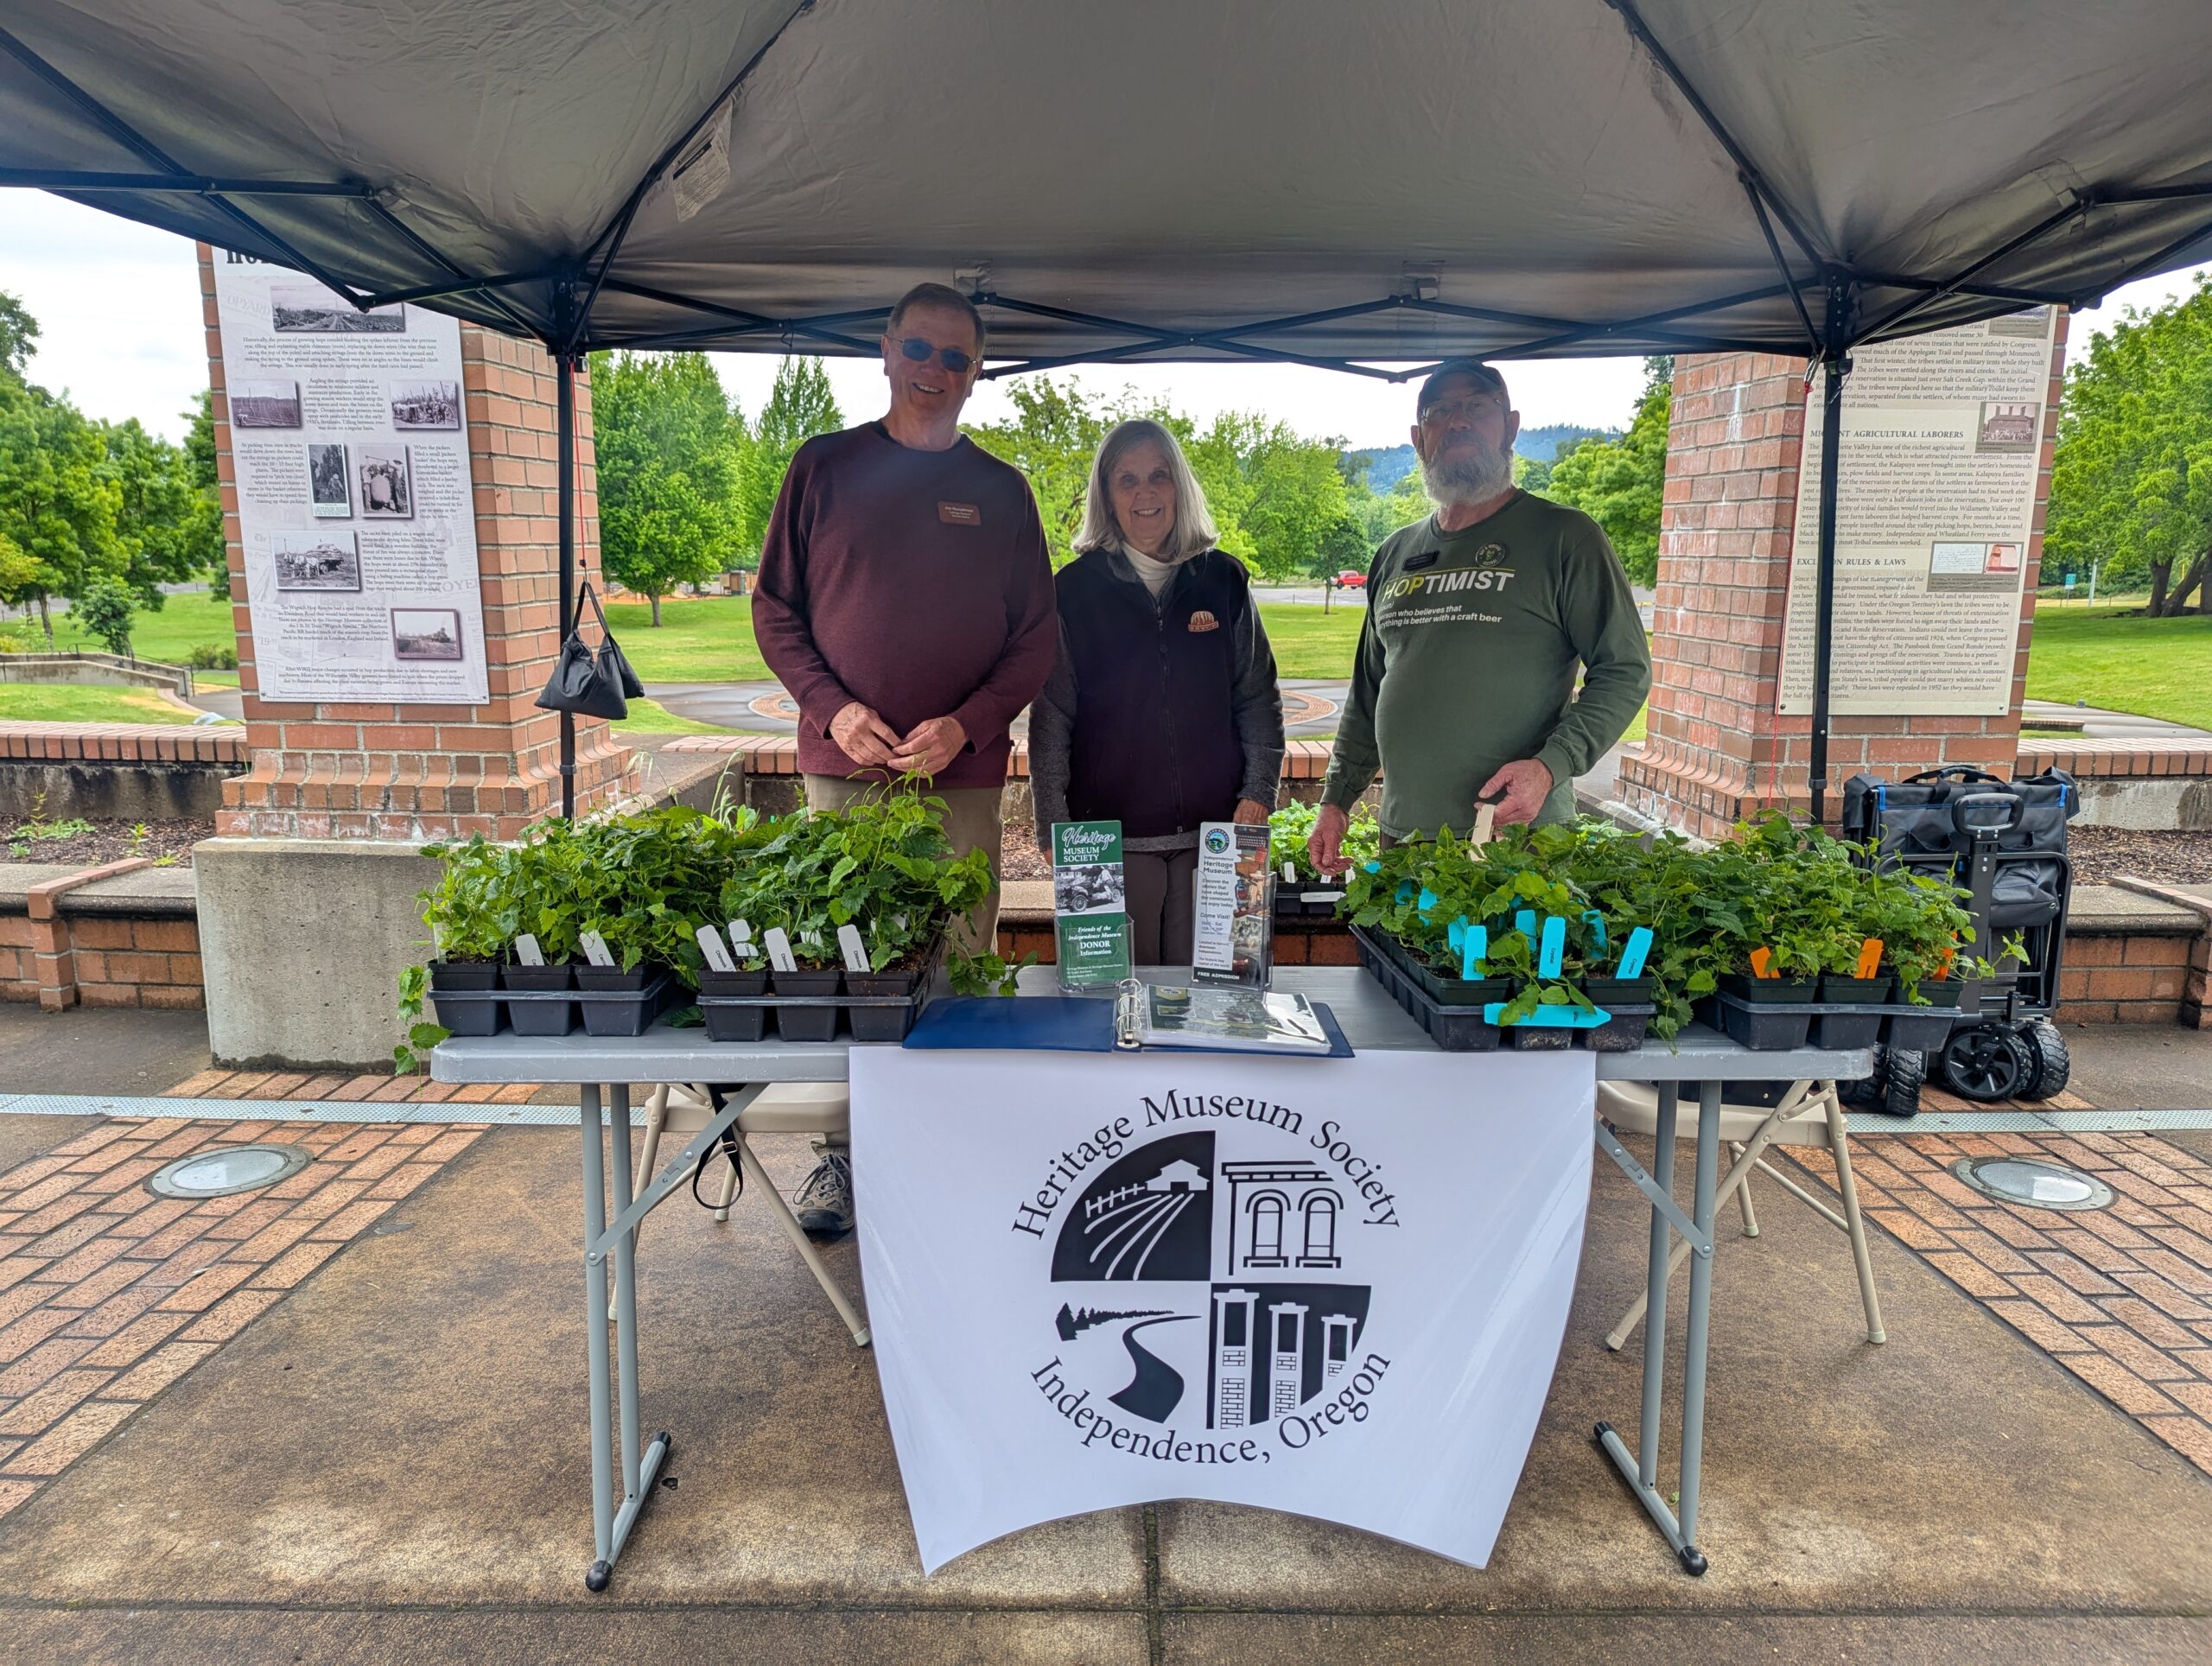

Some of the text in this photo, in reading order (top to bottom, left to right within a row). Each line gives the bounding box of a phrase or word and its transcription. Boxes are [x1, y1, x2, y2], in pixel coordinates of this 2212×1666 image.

[2010, 340, 2037, 349] Congress.
[1908, 347, 1936, 357] Applegate
[1964, 348, 1983, 358] passed
[1984, 348, 2007, 358] through
[1853, 442, 1871, 451] Valley
[1931, 442, 1965, 452] agricultural
[1866, 486, 1891, 495] majority
[1898, 486, 1917, 496] people
[1840, 520, 1858, 530] people
[1916, 521, 1933, 531] valley
[1934, 521, 1955, 531] picking
[1382, 570, 1514, 602] HOPTIMIST
[1414, 607, 1444, 616] believes
[1479, 614, 1502, 623] beer
[1896, 683, 1920, 692] repealed
[1949, 683, 1962, 692] they
[1062, 825, 1116, 850] Heritage
[1204, 861, 1233, 869] Heritage
[1080, 940, 1110, 949] DONOR
[715, 951, 728, 968] Chinook
[854, 951, 862, 968] Chinook
[1629, 958, 1637, 975] Crystal
[1012, 1089, 1400, 1240] Heritage Museum Society
[1031, 1352, 1390, 1463] Independence, Oregon
